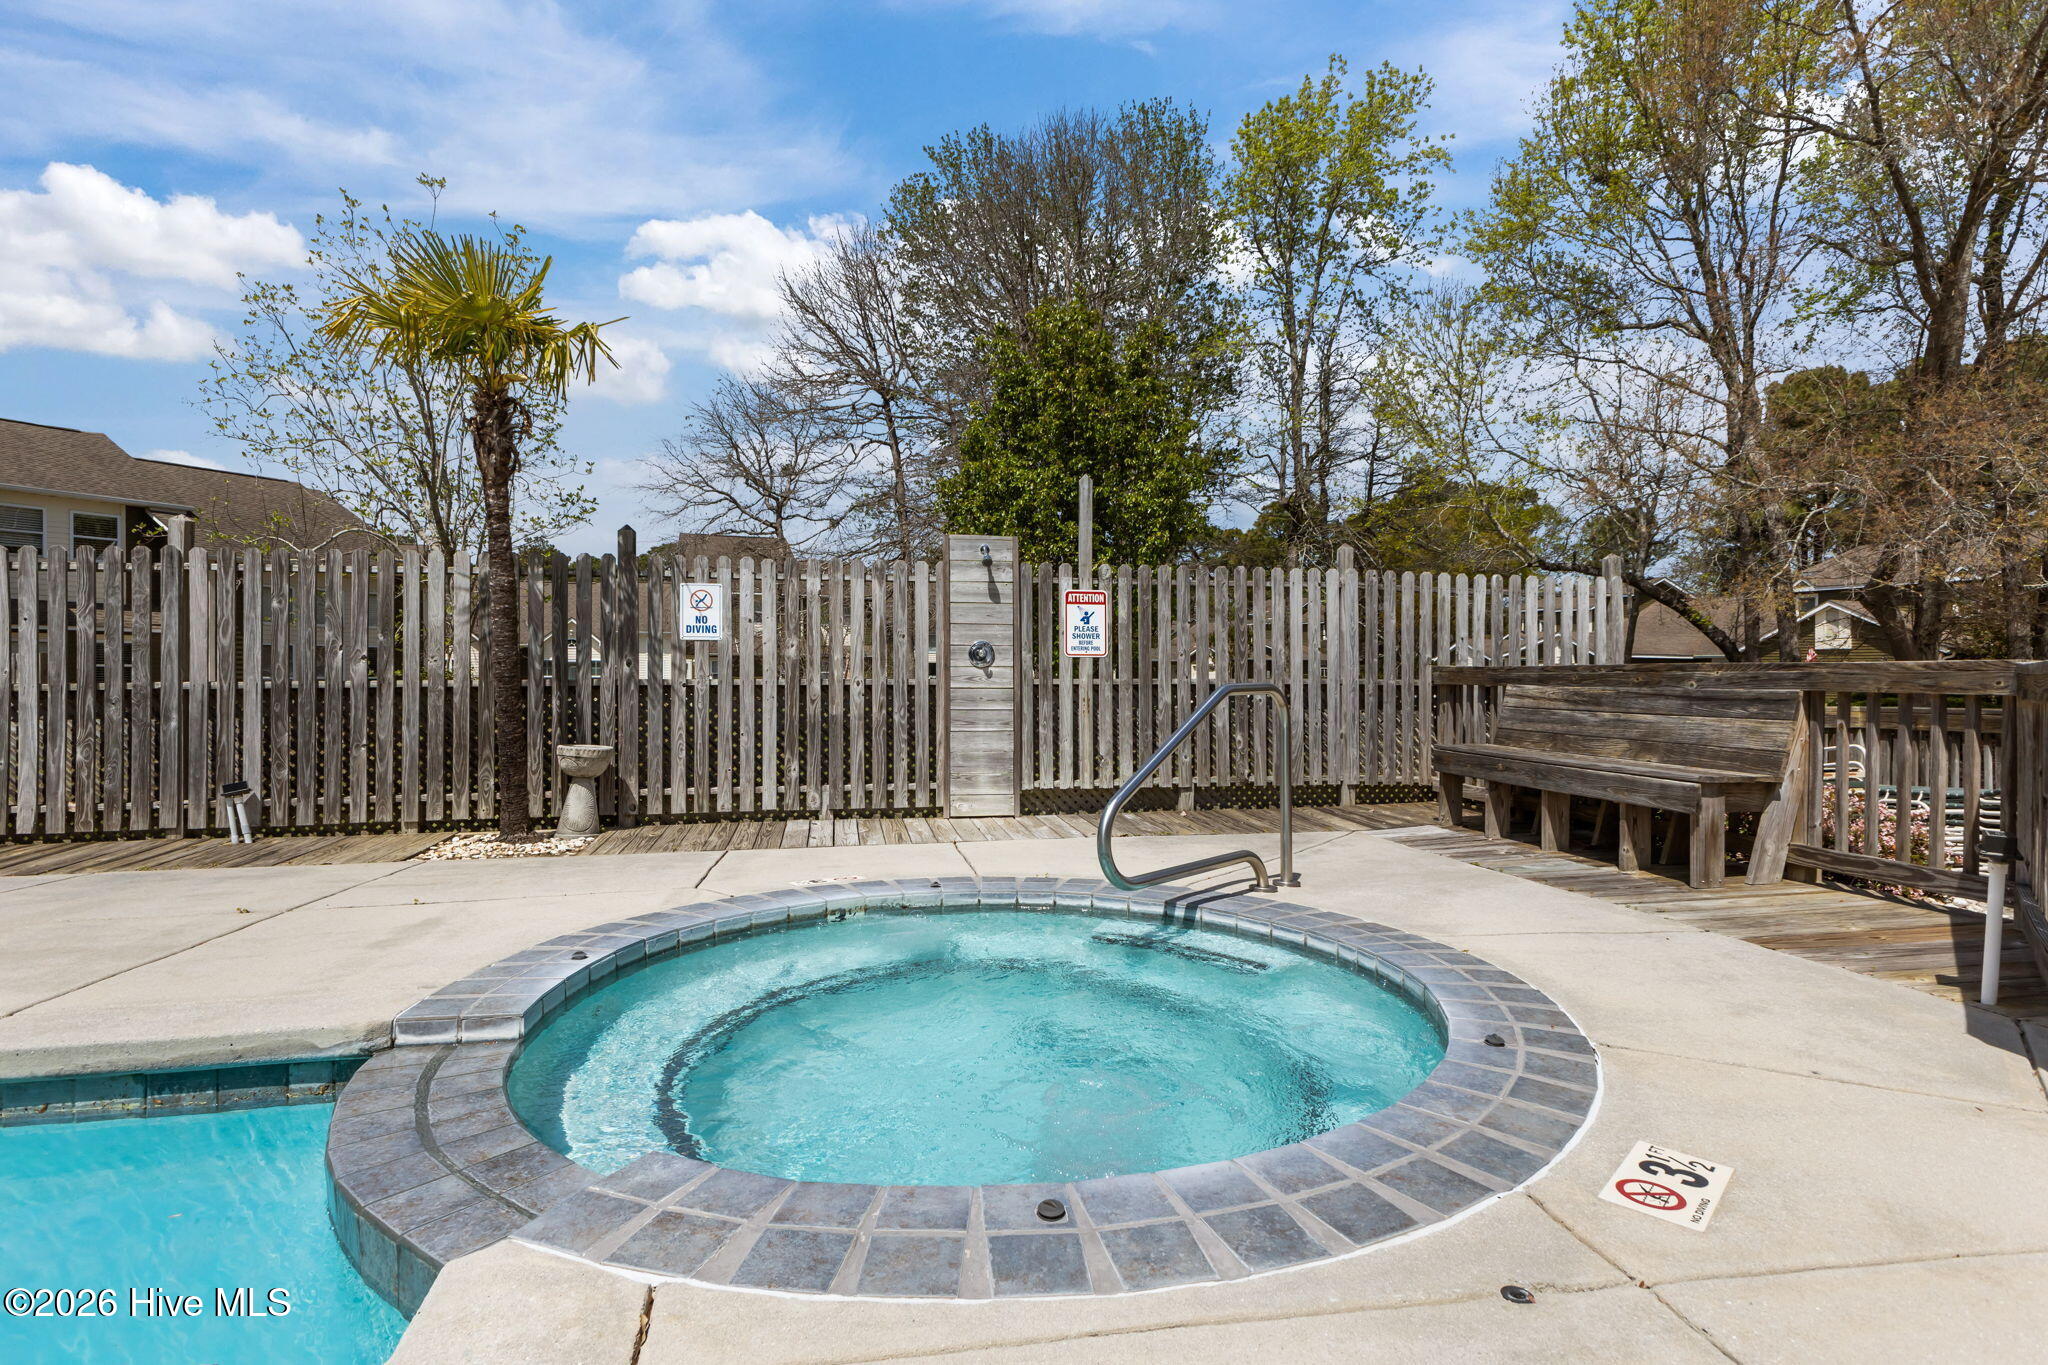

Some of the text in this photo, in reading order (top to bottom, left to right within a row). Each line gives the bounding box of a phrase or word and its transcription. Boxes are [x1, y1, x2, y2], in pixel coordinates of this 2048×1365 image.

[1067, 593, 1105, 603] ATTENTION
[695, 615, 708, 624] NO
[686, 625, 717, 633] DIVING
[1690, 1198, 1711, 1224] NO DIVING
